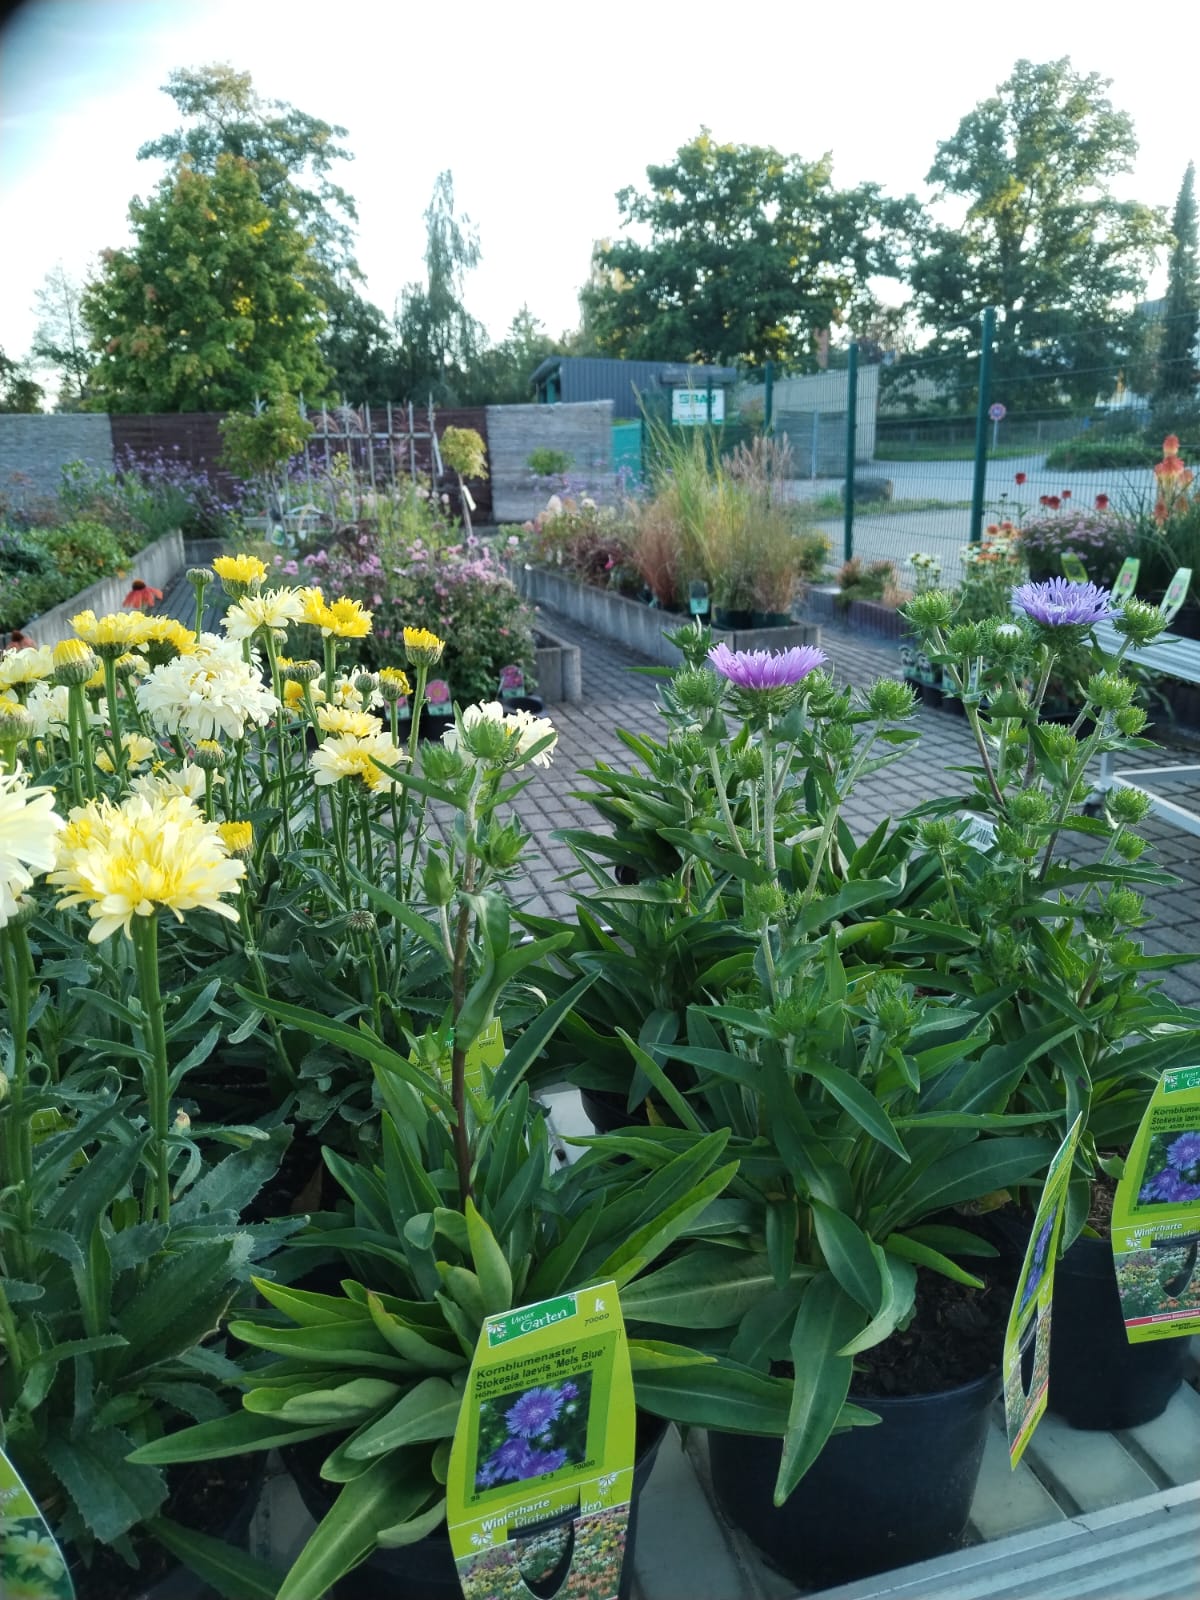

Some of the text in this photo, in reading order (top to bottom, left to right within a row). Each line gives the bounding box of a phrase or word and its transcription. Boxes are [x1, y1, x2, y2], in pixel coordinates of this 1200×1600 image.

[511, 1311, 536, 1325] Unser
[520, 1309, 568, 1332] Garten
[475, 1371, 520, 1391] Stokesia
[522, 1363, 551, 1378] laevis
[476, 1346, 577, 1380] Kornblumenaster
[481, 1500, 551, 1532] Winterharte
